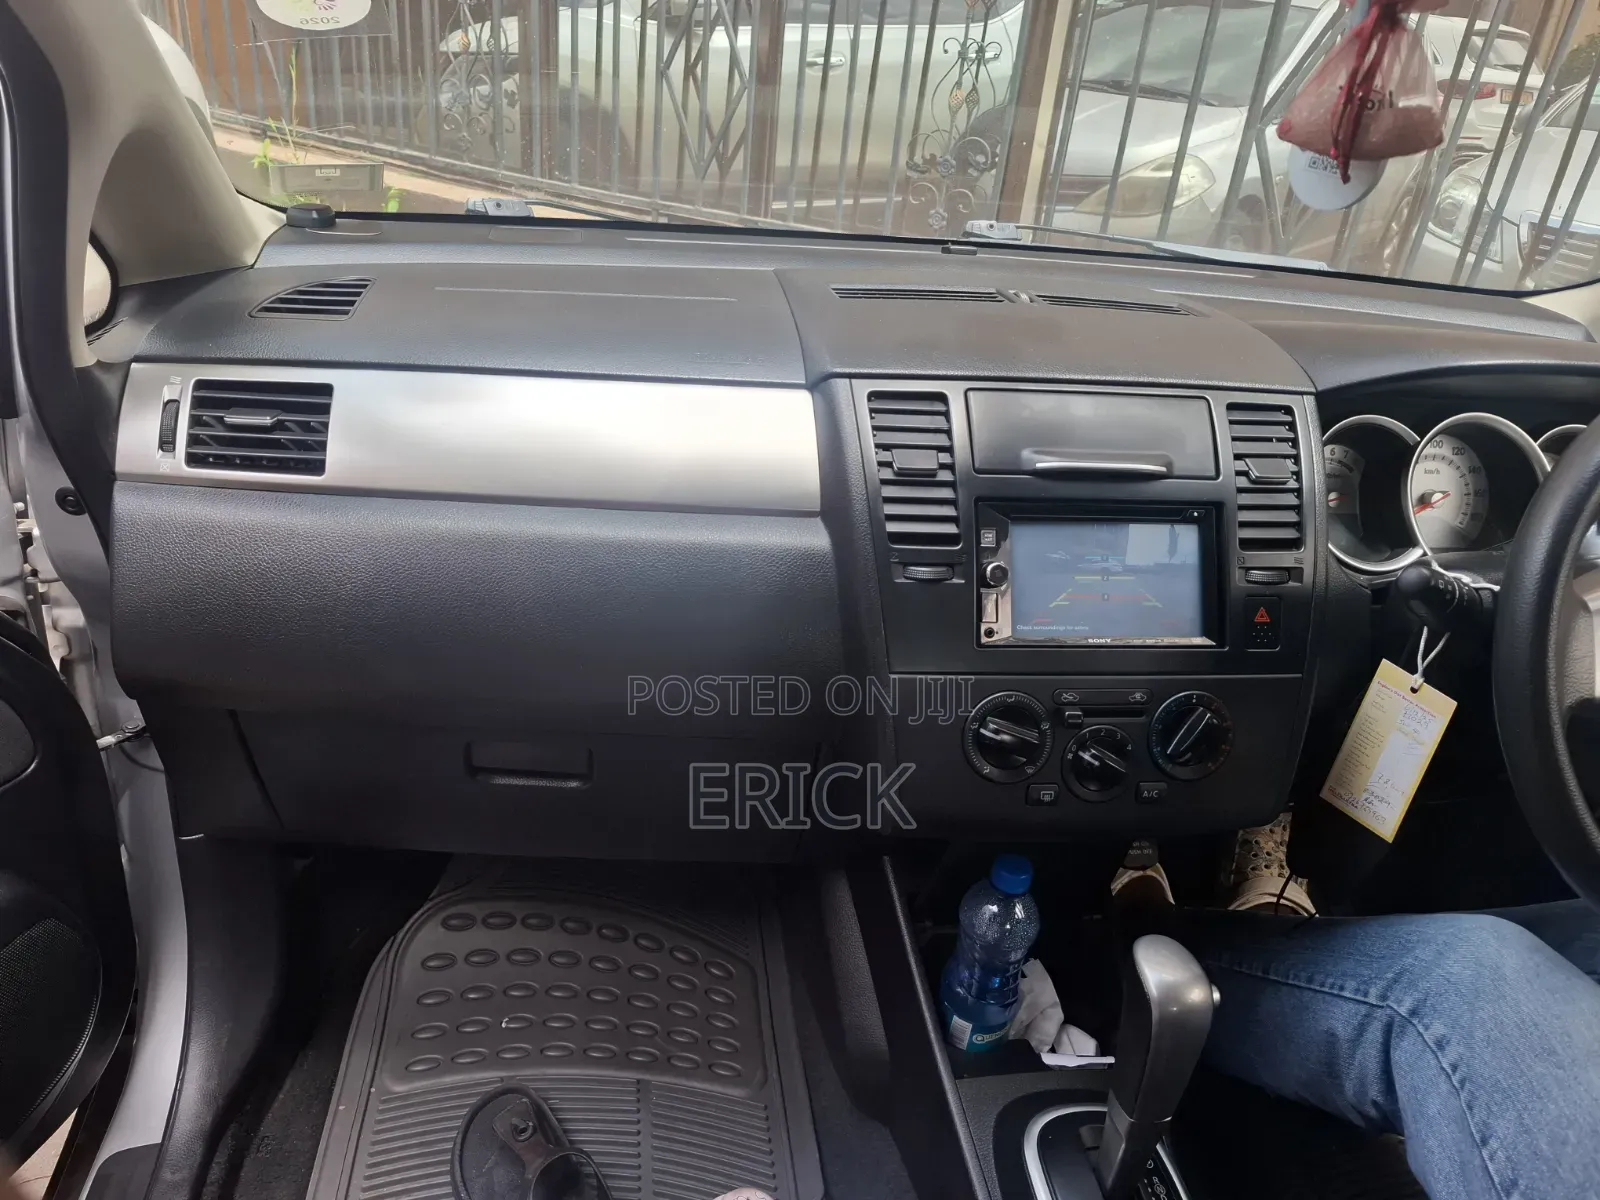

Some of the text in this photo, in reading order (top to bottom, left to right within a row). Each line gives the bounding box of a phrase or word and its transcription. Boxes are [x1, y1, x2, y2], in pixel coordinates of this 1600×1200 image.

[1428, 440, 1444, 449] 100
[1329, 447, 1336, 457] 6
[1343, 449, 1350, 459] 7
[1451, 446, 1466, 456] 120
[1423, 467, 1441, 475] km/h
[1142, 790, 1159, 798] A/C
[1152, 1176, 1160, 1184] R
